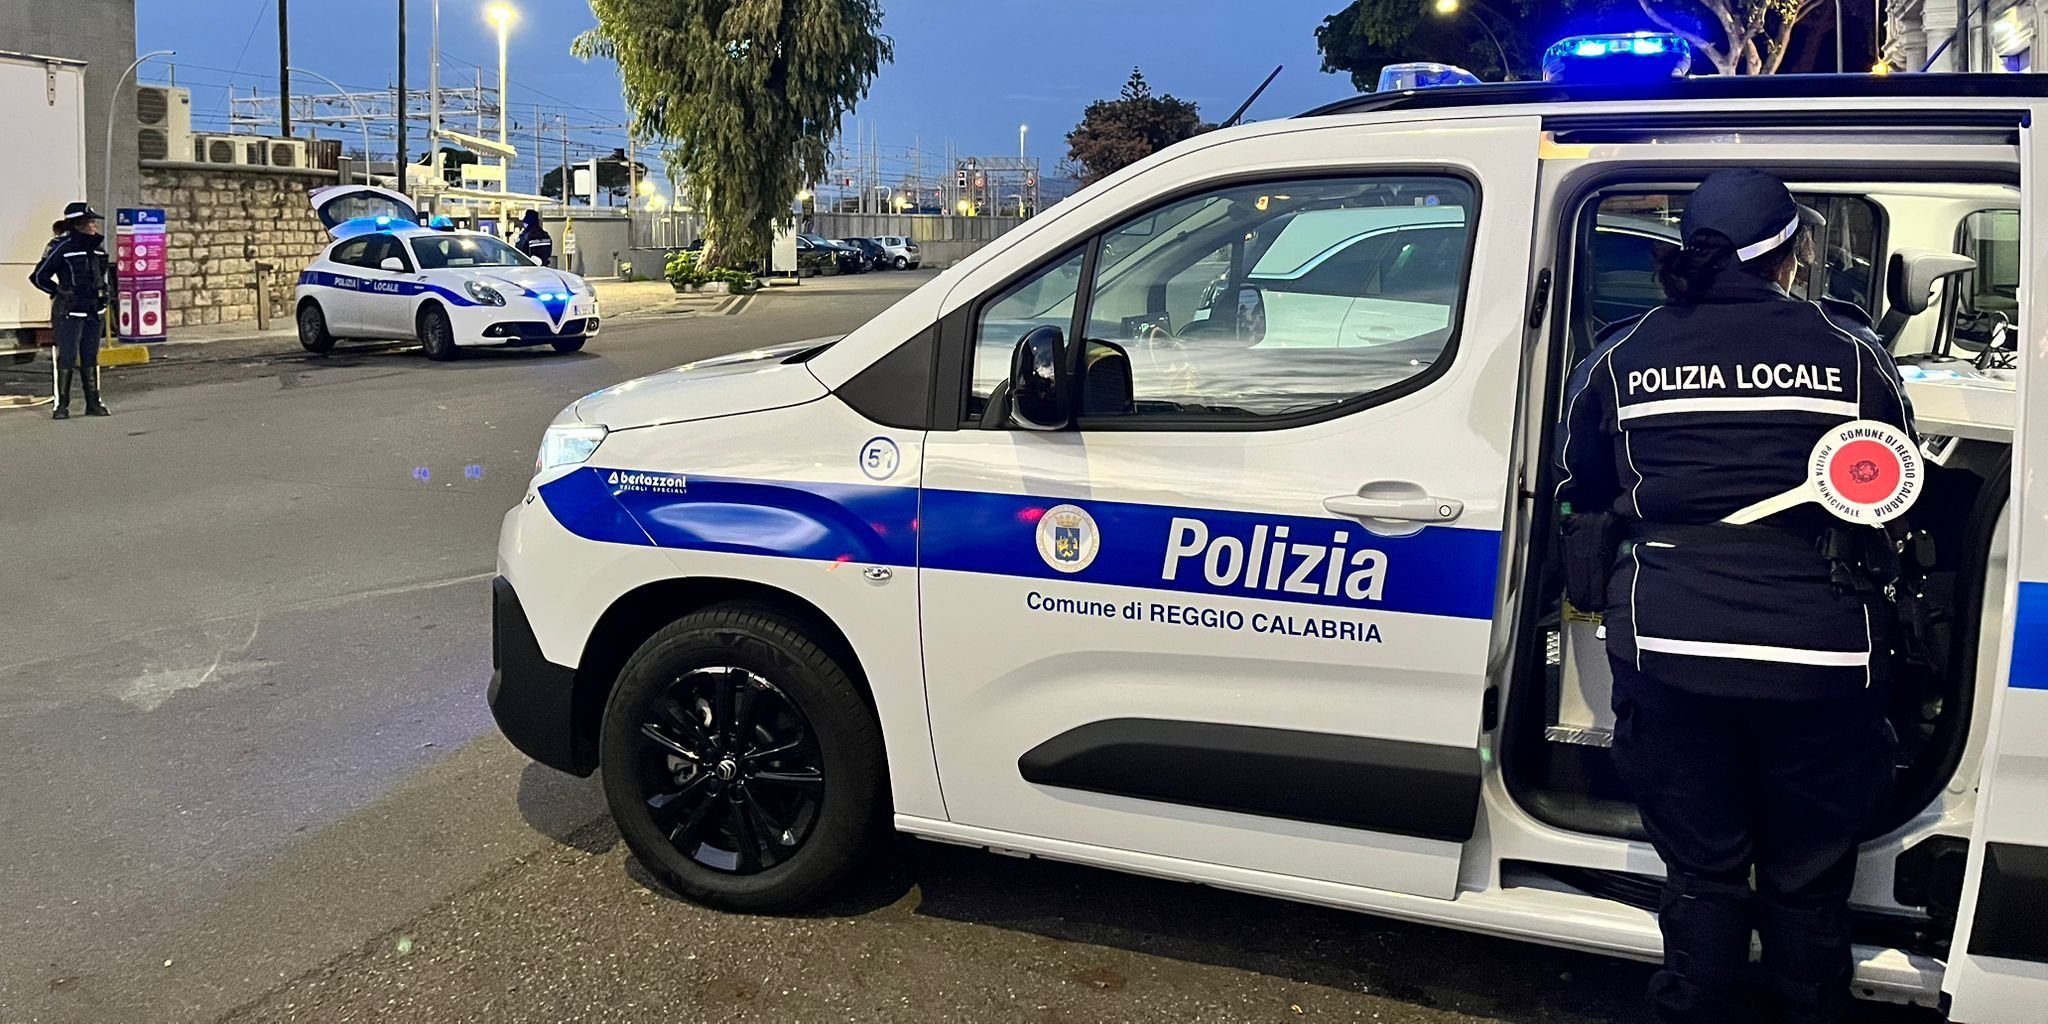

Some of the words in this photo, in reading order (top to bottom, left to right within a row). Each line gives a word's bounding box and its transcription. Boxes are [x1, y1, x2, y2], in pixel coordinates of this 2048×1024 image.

[334, 277, 356, 288] POLIZIA
[373, 281, 399, 292] LOCALE
[1629, 364, 1725, 395] POLIZIA
[1736, 363, 1842, 392] LOCALE
[1840, 428, 1884, 441] COMUNE
[1885, 435, 1898, 446] DI
[867, 448, 893, 469] 51
[1815, 444, 1832, 476] POLIZIA
[1895, 444, 1915, 479] REGGIO
[620, 471, 686, 488] bertazzoni
[653, 486, 687, 494] SPECIALI
[1817, 480, 1861, 517] MUNICIPALE
[1874, 481, 1914, 517] CALABRIA
[1161, 517, 1389, 601] Polizia
[1026, 591, 1116, 618] Comune
[1122, 601, 1142, 621] di
[1149, 603, 1244, 631] REGGIO
[1251, 614, 1383, 643] CALABRIA
